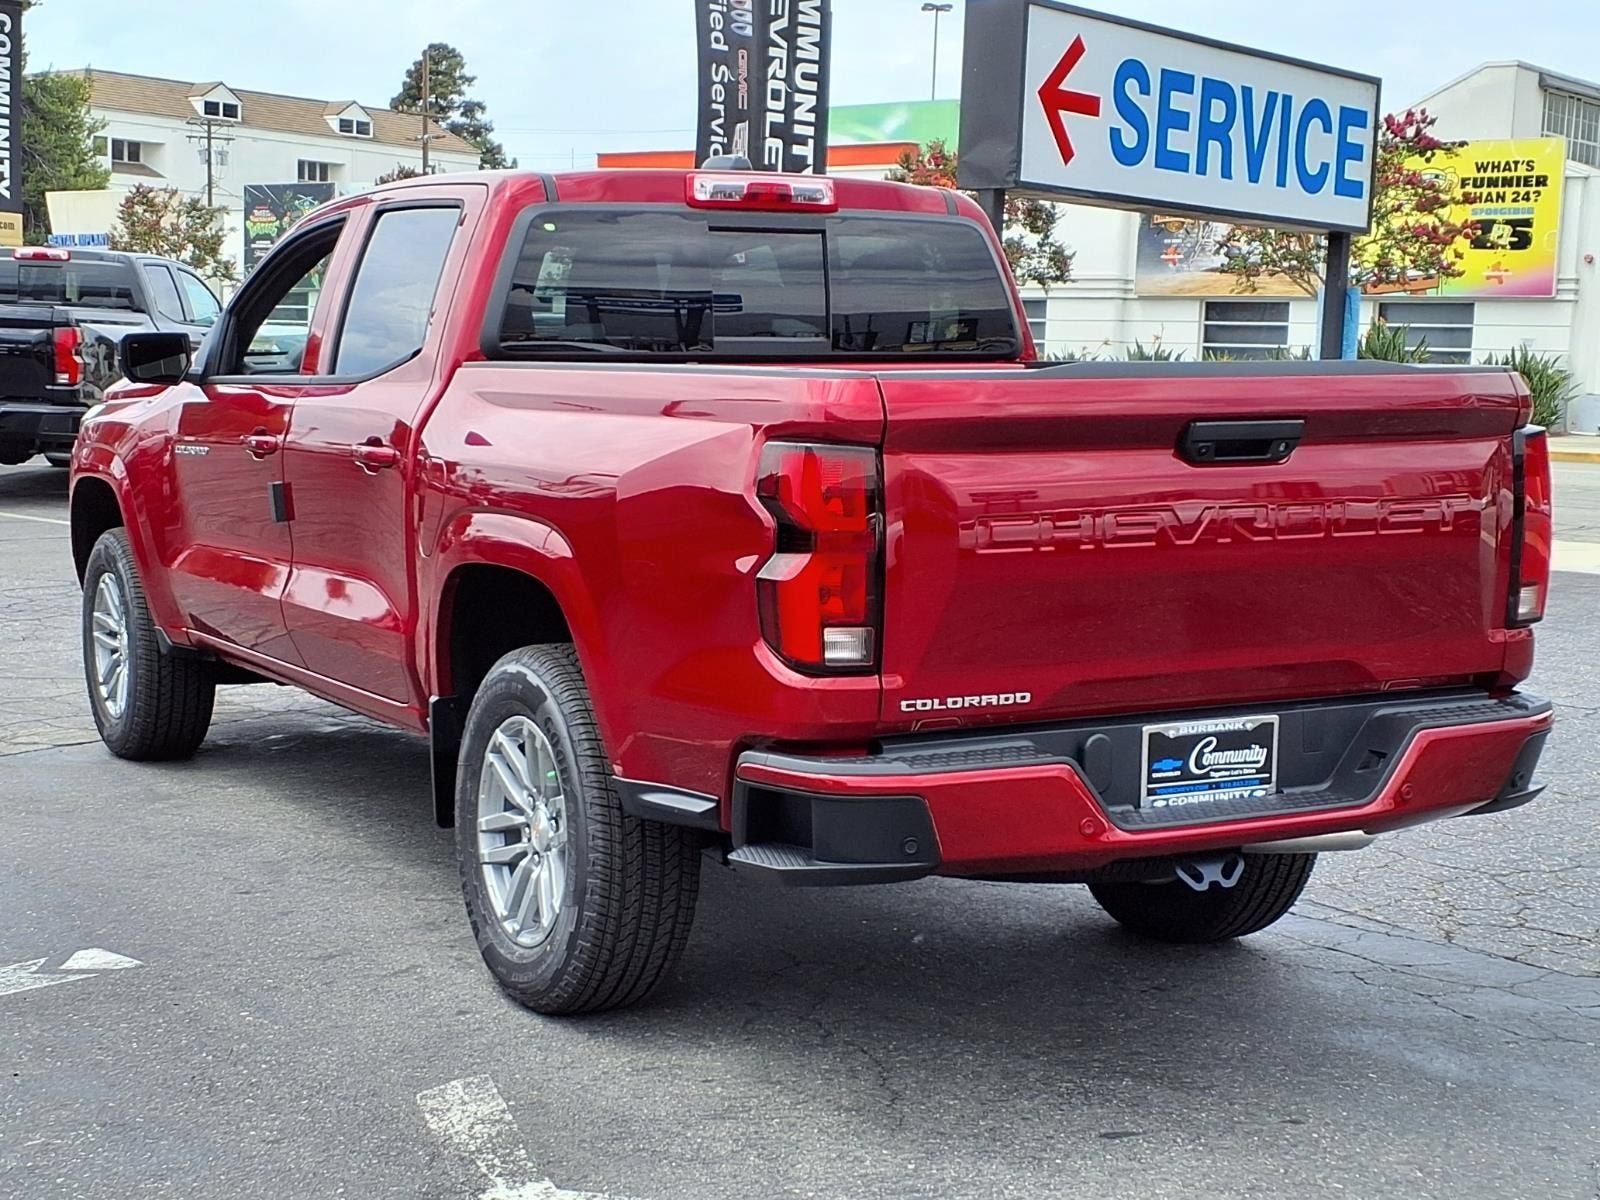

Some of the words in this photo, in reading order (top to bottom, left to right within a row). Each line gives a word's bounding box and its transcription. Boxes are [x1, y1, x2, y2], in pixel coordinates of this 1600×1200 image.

[709, 0, 729, 51] ied
[792, 0, 822, 174] MMUNIT
[1109, 58, 1369, 199] SERVICE
[1475, 160, 1535, 173] WHAT'S
[1460, 175, 1549, 189] FUNNIER
[1464, 191, 1506, 203] HAN
[1511, 190, 1542, 203] 24?
[975, 493, 1472, 554] CHEVROLET
[900, 692, 1032, 712] COLORADO
[1179, 722, 1245, 735] BURBANK
[1189, 736, 1268, 775] Community
